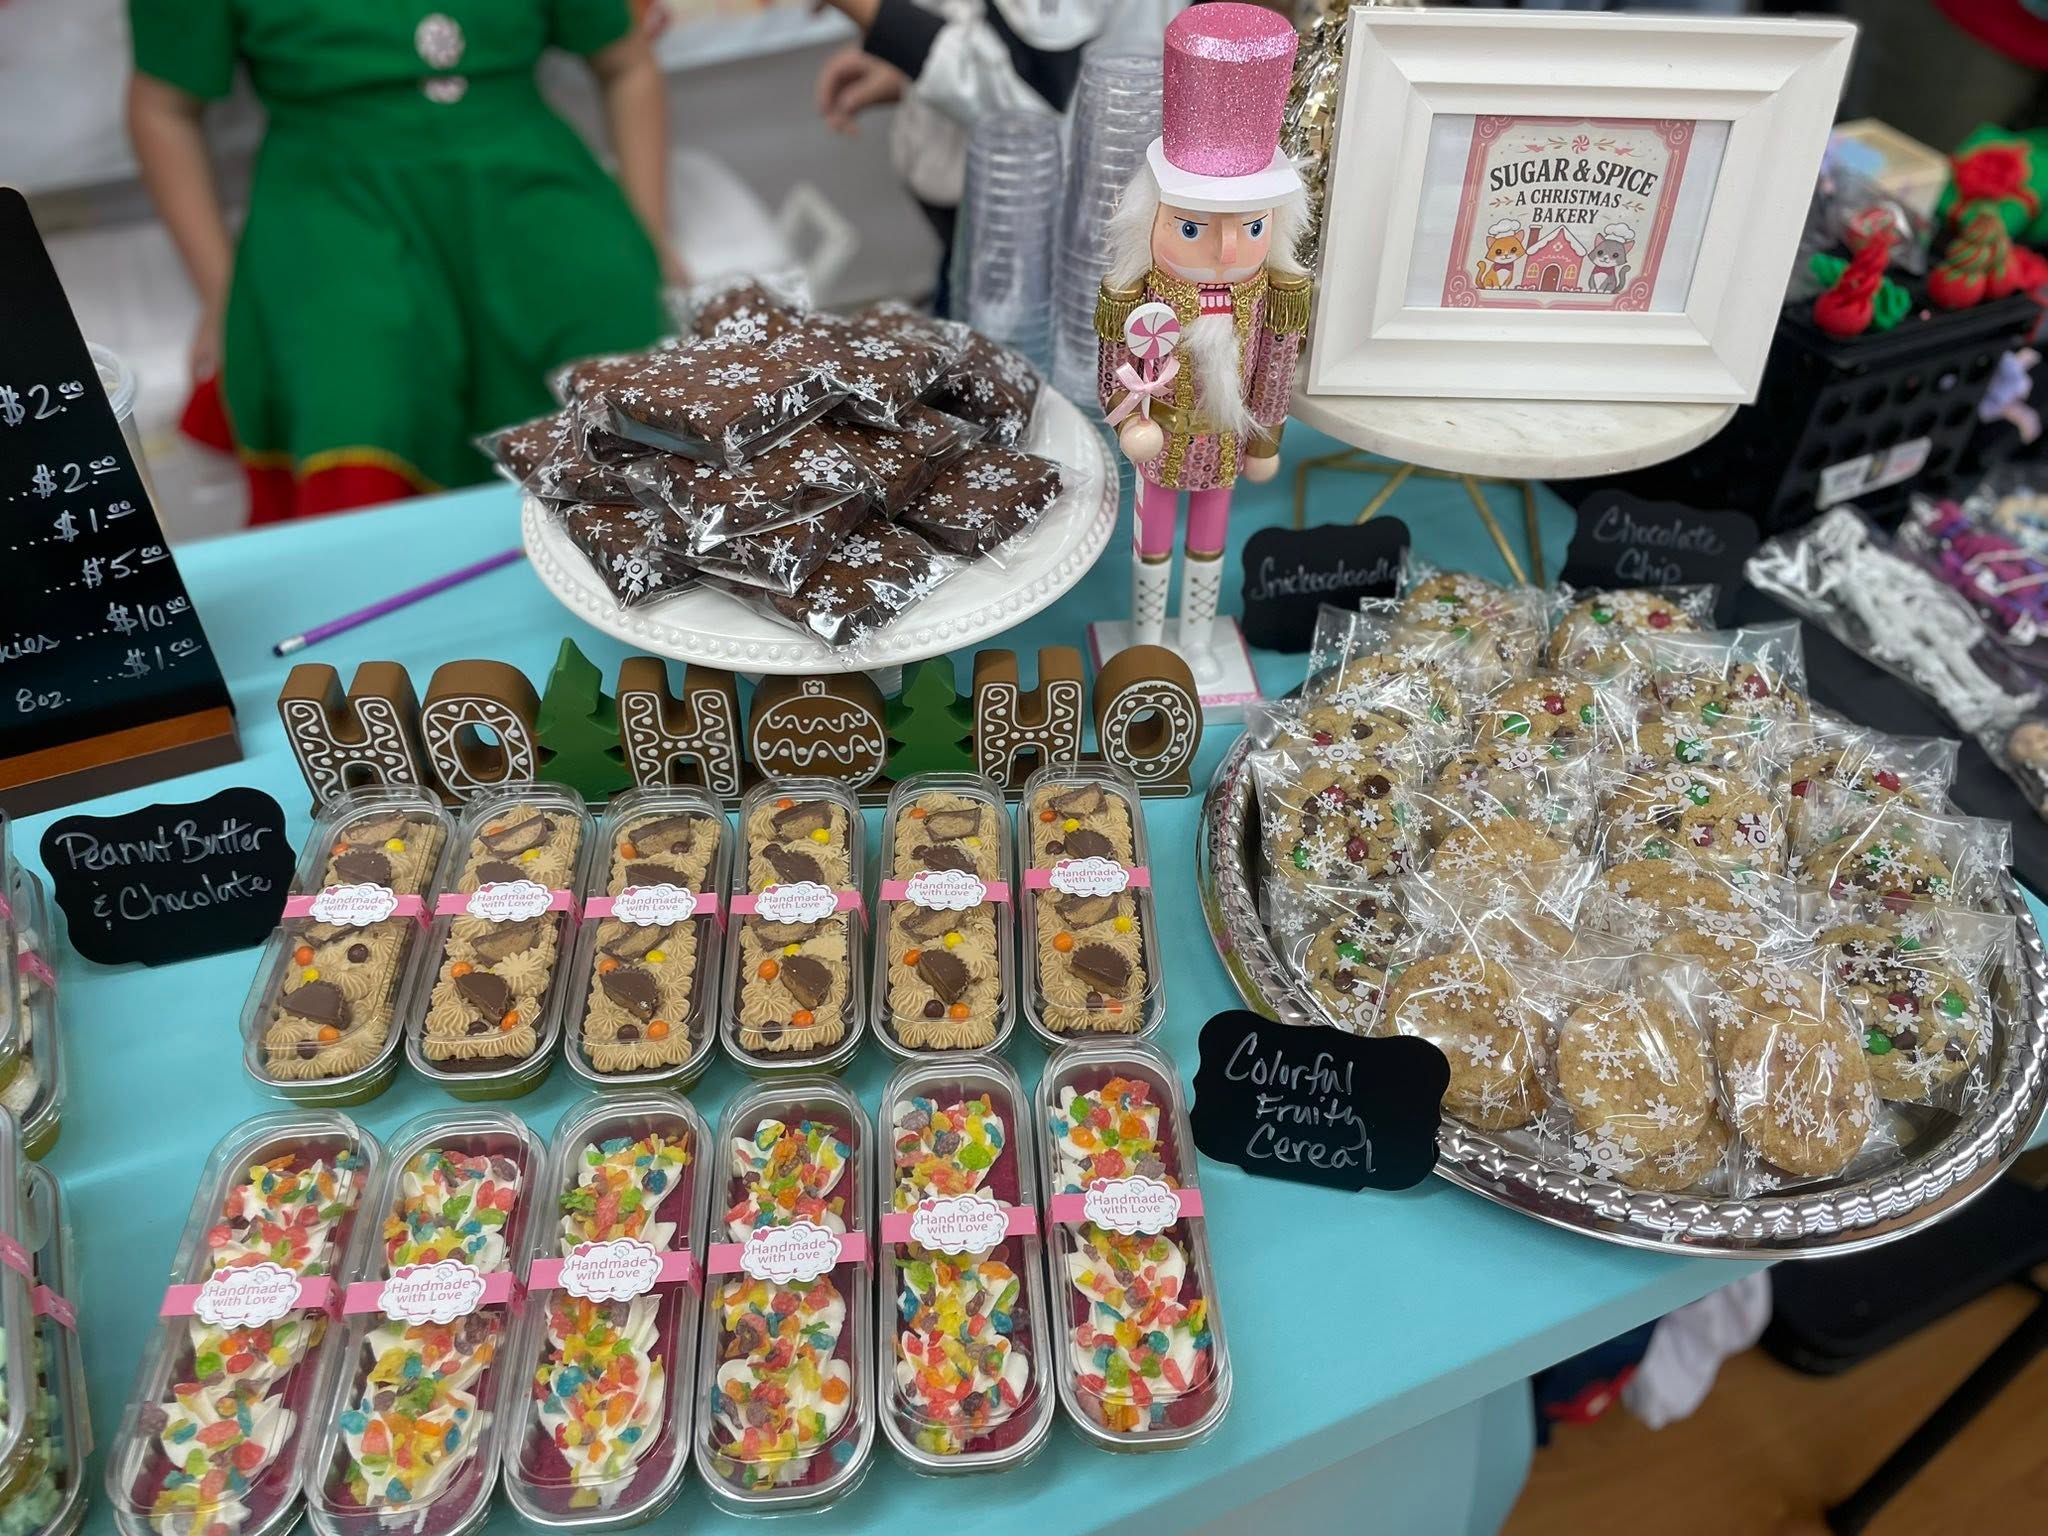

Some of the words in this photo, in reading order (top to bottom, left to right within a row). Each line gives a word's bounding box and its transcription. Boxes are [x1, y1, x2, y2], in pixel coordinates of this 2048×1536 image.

[1490, 158, 1570, 192] SUGAR
[1572, 159, 1591, 182] &
[1592, 160, 1658, 197] SPICE
[1516, 191, 1526, 206] A
[1530, 189, 1622, 209] CHRISTMAS
[1532, 208, 1599, 224] BAKERY
[1592, 505, 1725, 555] Chocolate
[1615, 547, 1682, 586] Chip
[55, 825, 173, 870] Peanut
[174, 818, 272, 863] Butter
[1057, 868, 1117, 878] Handmade
[1063, 875, 1087, 884] with
[1089, 874, 1113, 883] Love
[914, 881, 974, 891] Handmade
[919, 888, 943, 897] with
[945, 888, 969, 897] Love
[119, 870, 272, 920] Chocolate
[321, 895, 385, 905] Handmade
[477, 893, 540, 903] Handmade
[621, 896, 684, 905] Handmade
[764, 893, 826, 903] Handmade
[324, 903, 348, 912] with
[350, 902, 378, 911] Love
[481, 900, 505, 909] with
[507, 899, 534, 908] Love
[625, 903, 650, 911] with
[652, 902, 678, 911] Love
[768, 901, 792, 910] with
[794, 901, 820, 909] Love
[1224, 1032, 1354, 1095] Colorful
[1256, 1093, 1368, 1150] Fruity
[1246, 1122, 1376, 1173] Cereal
[1093, 1194, 1165, 1206] Handmade
[1101, 1203, 1128, 1215] with
[1132, 1203, 1161, 1214] Love
[921, 1212, 993, 1225] Handmade
[927, 1222, 955, 1235] with
[960, 1222, 988, 1233] Love
[752, 1239, 827, 1255] Handmade
[571, 1256, 648, 1271] Handmade
[758, 1252, 788, 1264] with
[790, 1250, 820, 1262] Love
[576, 1269, 606, 1281] with
[609, 1267, 640, 1279] Love
[209, 1283, 286, 1297] Handmade
[392, 1279, 472, 1294] Handmade
[213, 1295, 241, 1307] with
[245, 1294, 277, 1305] Love
[397, 1291, 427, 1303] with
[430, 1290, 462, 1302] Love
